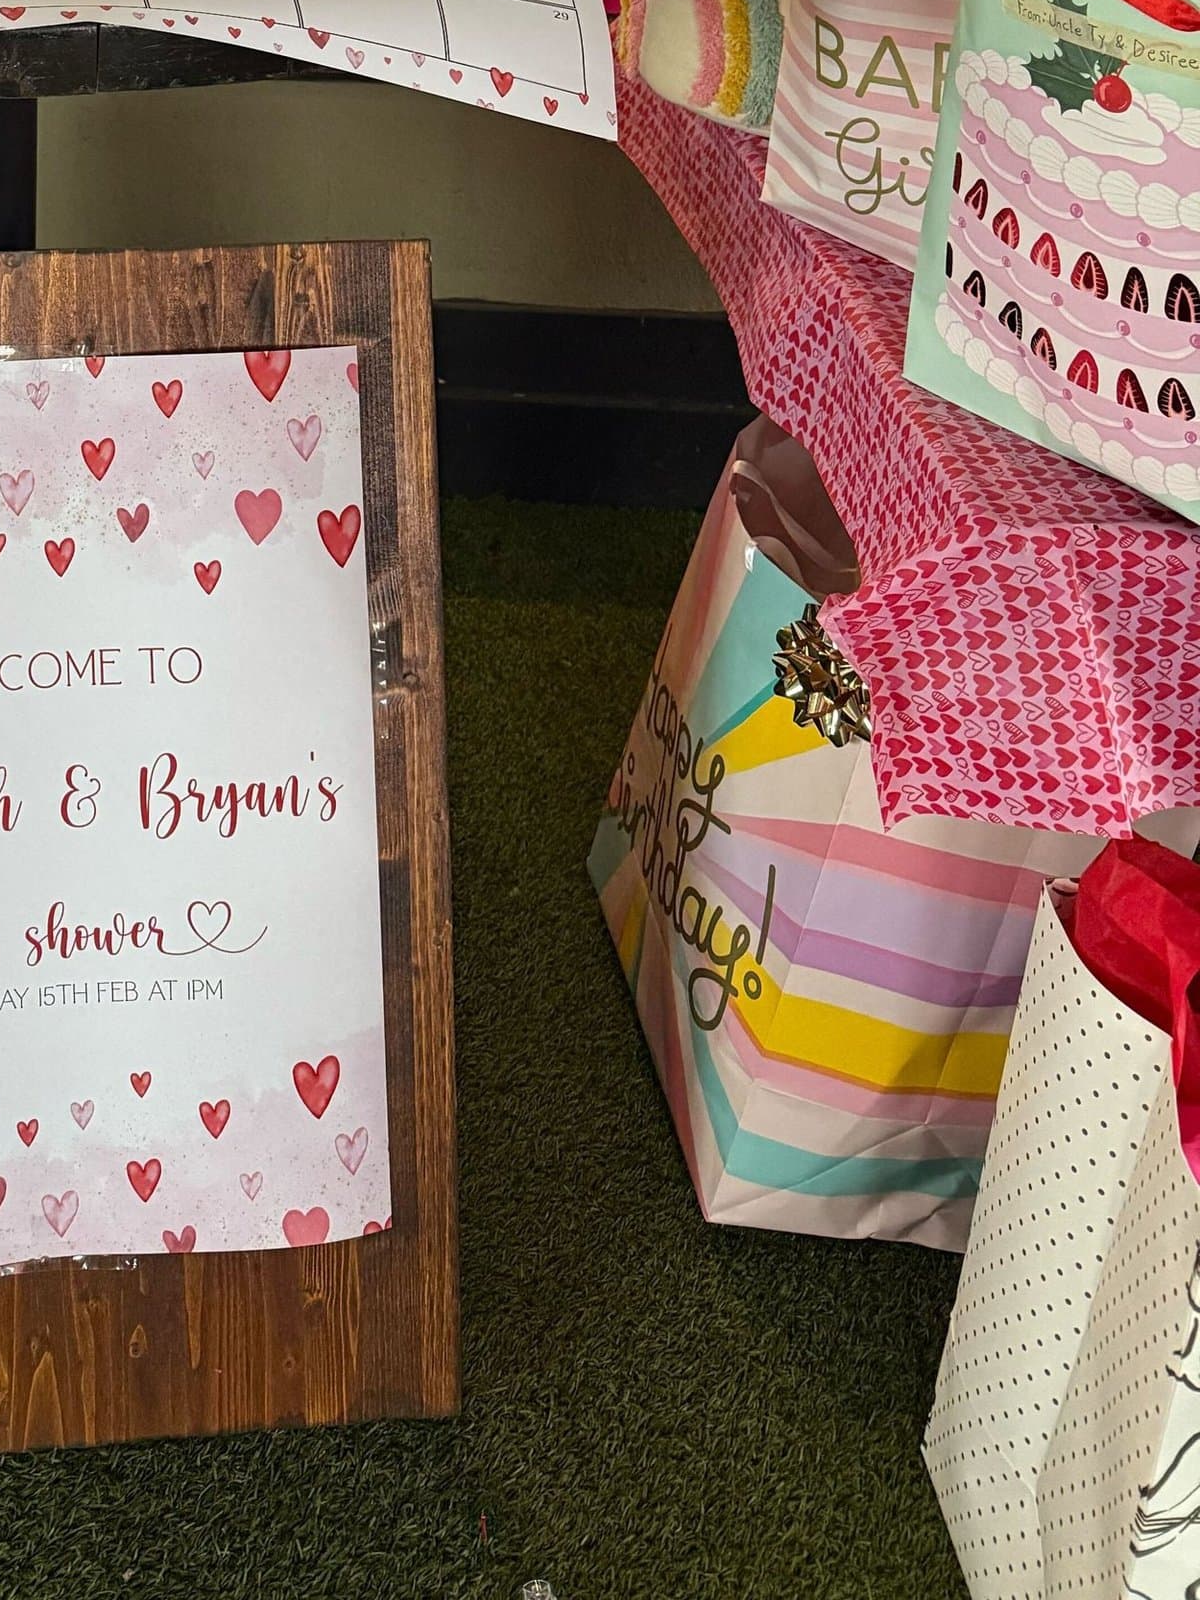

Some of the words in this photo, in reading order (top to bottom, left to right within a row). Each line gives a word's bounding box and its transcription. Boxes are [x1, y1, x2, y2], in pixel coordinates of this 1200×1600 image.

[553, 10, 570, 21] 29
[1047, 6, 1082, 38] Uncle
[1087, 23, 1105, 47] Ty
[1115, 35, 1128, 50] &
[1133, 39, 1200, 68] Desiree
[138, 647, 203, 684] TO
[60, 764, 101, 828] &
[139, 751, 344, 840] Bryan's
[24, 901, 168, 967] shower
[38, 982, 88, 1008] 15TH
[96, 980, 139, 1002] FEB
[148, 979, 178, 1001] AT
[187, 978, 224, 1001] 1PM
